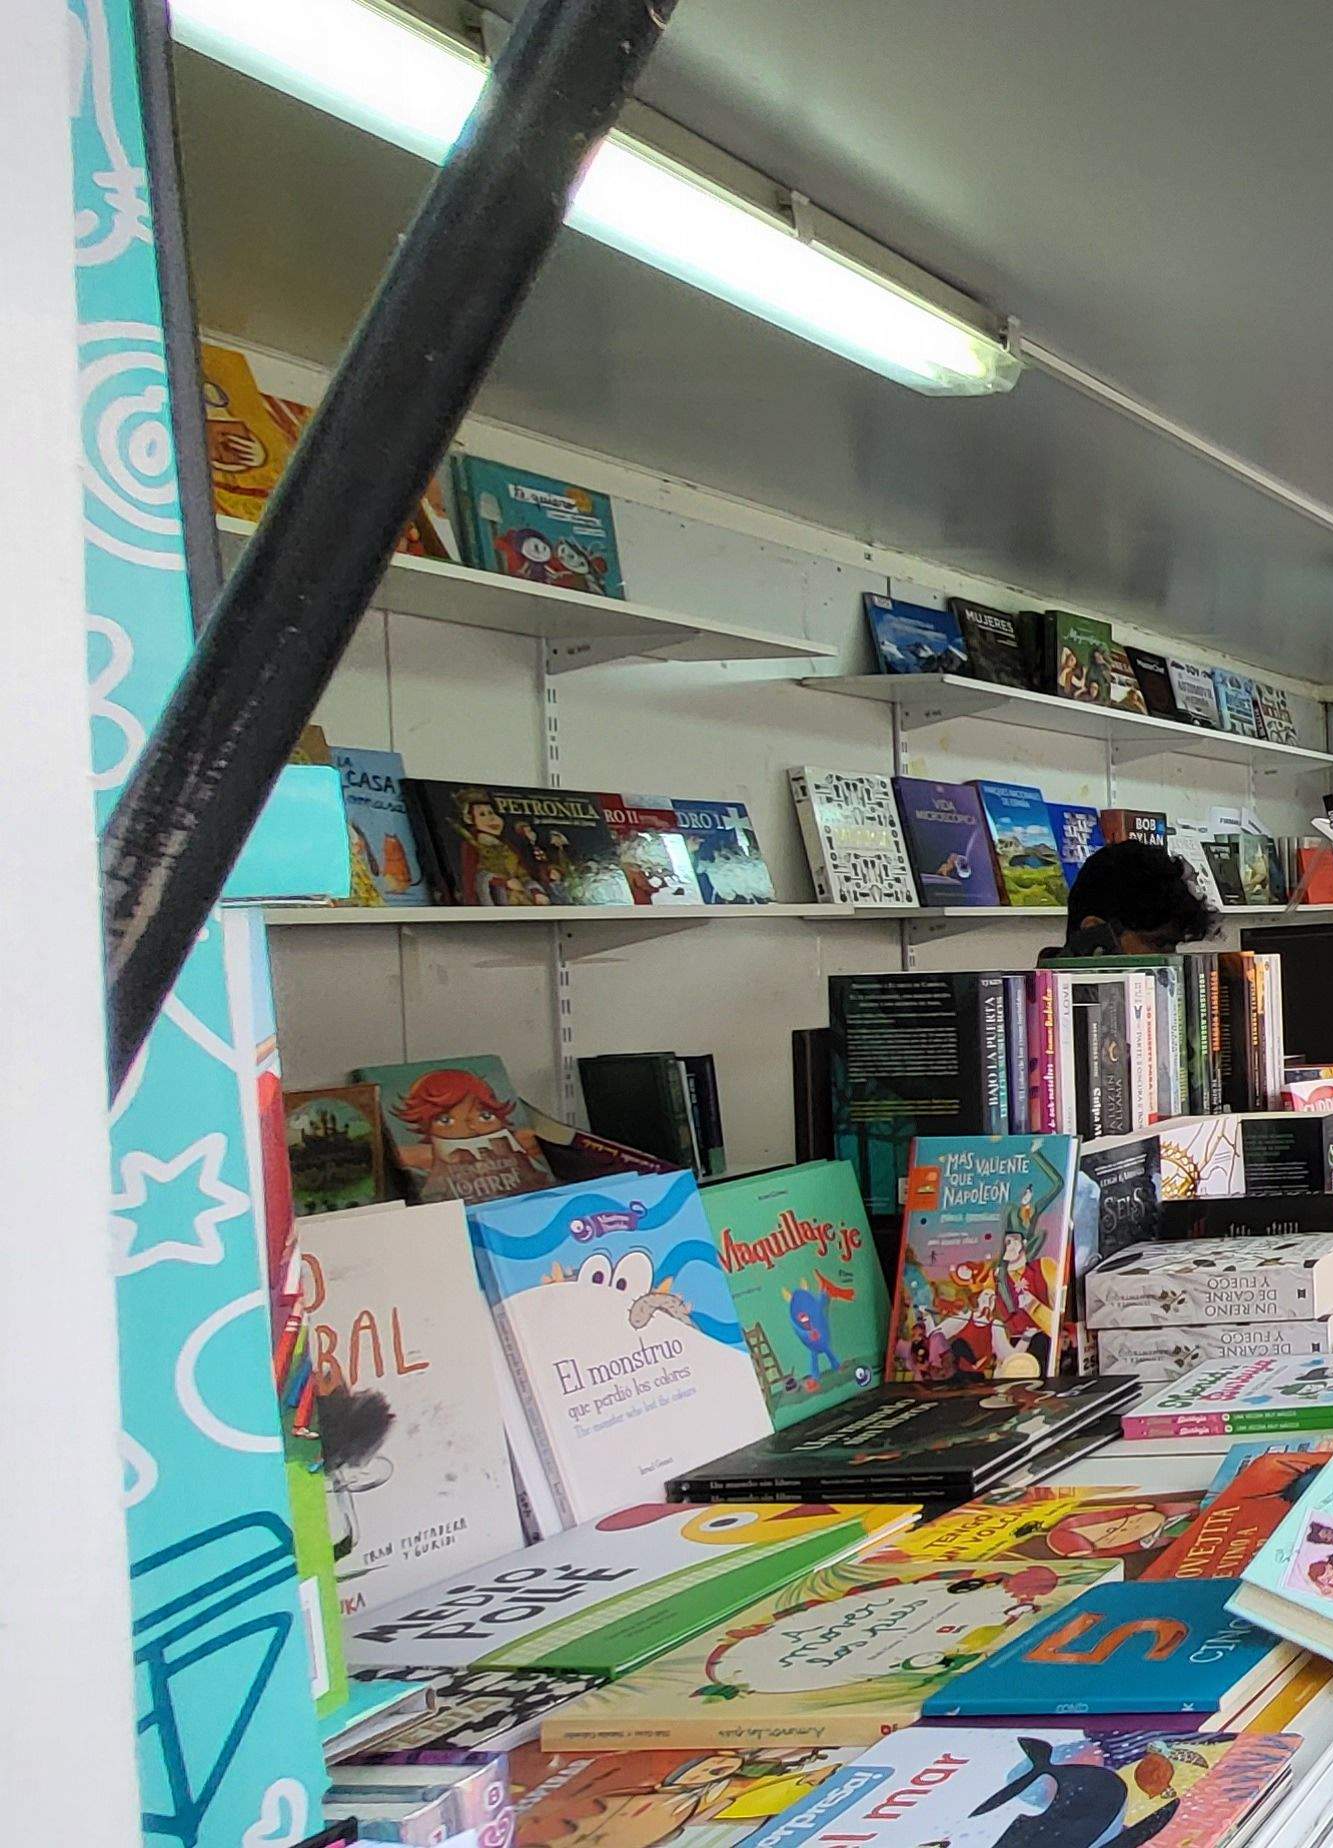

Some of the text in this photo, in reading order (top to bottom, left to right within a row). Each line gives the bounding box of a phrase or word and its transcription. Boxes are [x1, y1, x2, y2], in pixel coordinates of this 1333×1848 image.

[964, 609, 1015, 635] MUJERES
[347, 771, 396, 795] CASA
[498, 799, 600, 820] PETRONILA
[677, 811, 714, 830] DRO
[1135, 817, 1157, 831] BOB
[1128, 830, 1164, 847] DYLAN
[984, 996, 1000, 1106] BAJO LA PUERTA
[944, 1151, 1031, 1177] MÁS VALIENTE
[950, 1173, 975, 1186] QUE
[943, 1180, 1011, 1210] NAPOLEÓN
[1205, 1289, 1278, 1304] DE CARNE
[1206, 1276, 1270, 1291] Y FUEGO
[1204, 1302, 1278, 1318] UN REINO
[1219, 1342, 1291, 1358] DE CARNE
[1220, 1330, 1285, 1345] Y FUEGO
[552, 1336, 684, 1396] El monstruo
[568, 1365, 692, 1422] que perdió los colores
[923, 1514, 993, 1549] TENGO
[1174, 1504, 1241, 1579] OVEJITA
[1216, 1538, 1251, 1570] VINO
[778, 1598, 895, 1668] mover
[806, 1599, 929, 1668] los pies
[1022, 1610, 1191, 1666] 5
[1189, 1616, 1253, 1666] CINC
[862, 1752, 970, 1819] mar
